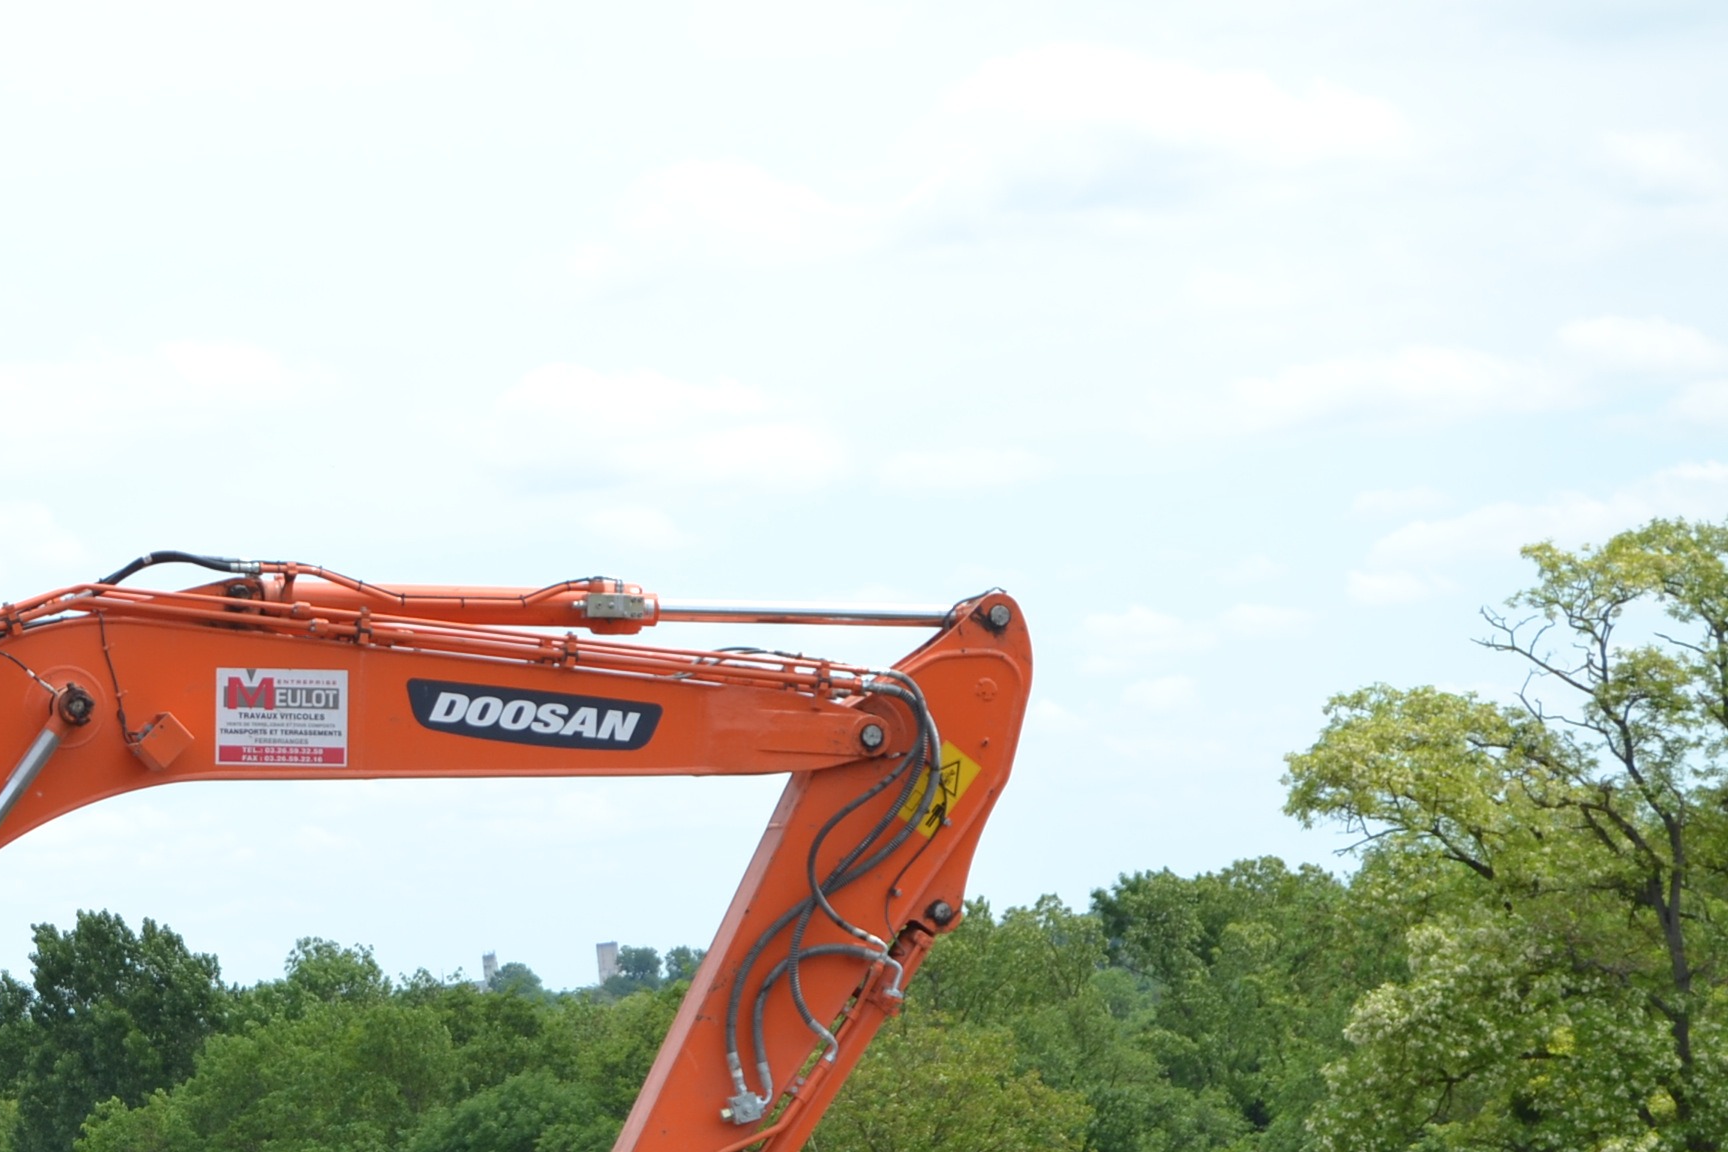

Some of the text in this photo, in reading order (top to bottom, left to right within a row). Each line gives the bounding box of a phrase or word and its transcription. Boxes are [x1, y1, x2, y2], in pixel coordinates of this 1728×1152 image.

[227, 677, 337, 710] MEULOT
[239, 712, 325, 721] TRAVAUX VITICOLES
[428, 691, 641, 742] DOOSAN
[220, 728, 268, 736] TRANSPORTS
[280, 729, 342, 737] TERRASSEMENTS
